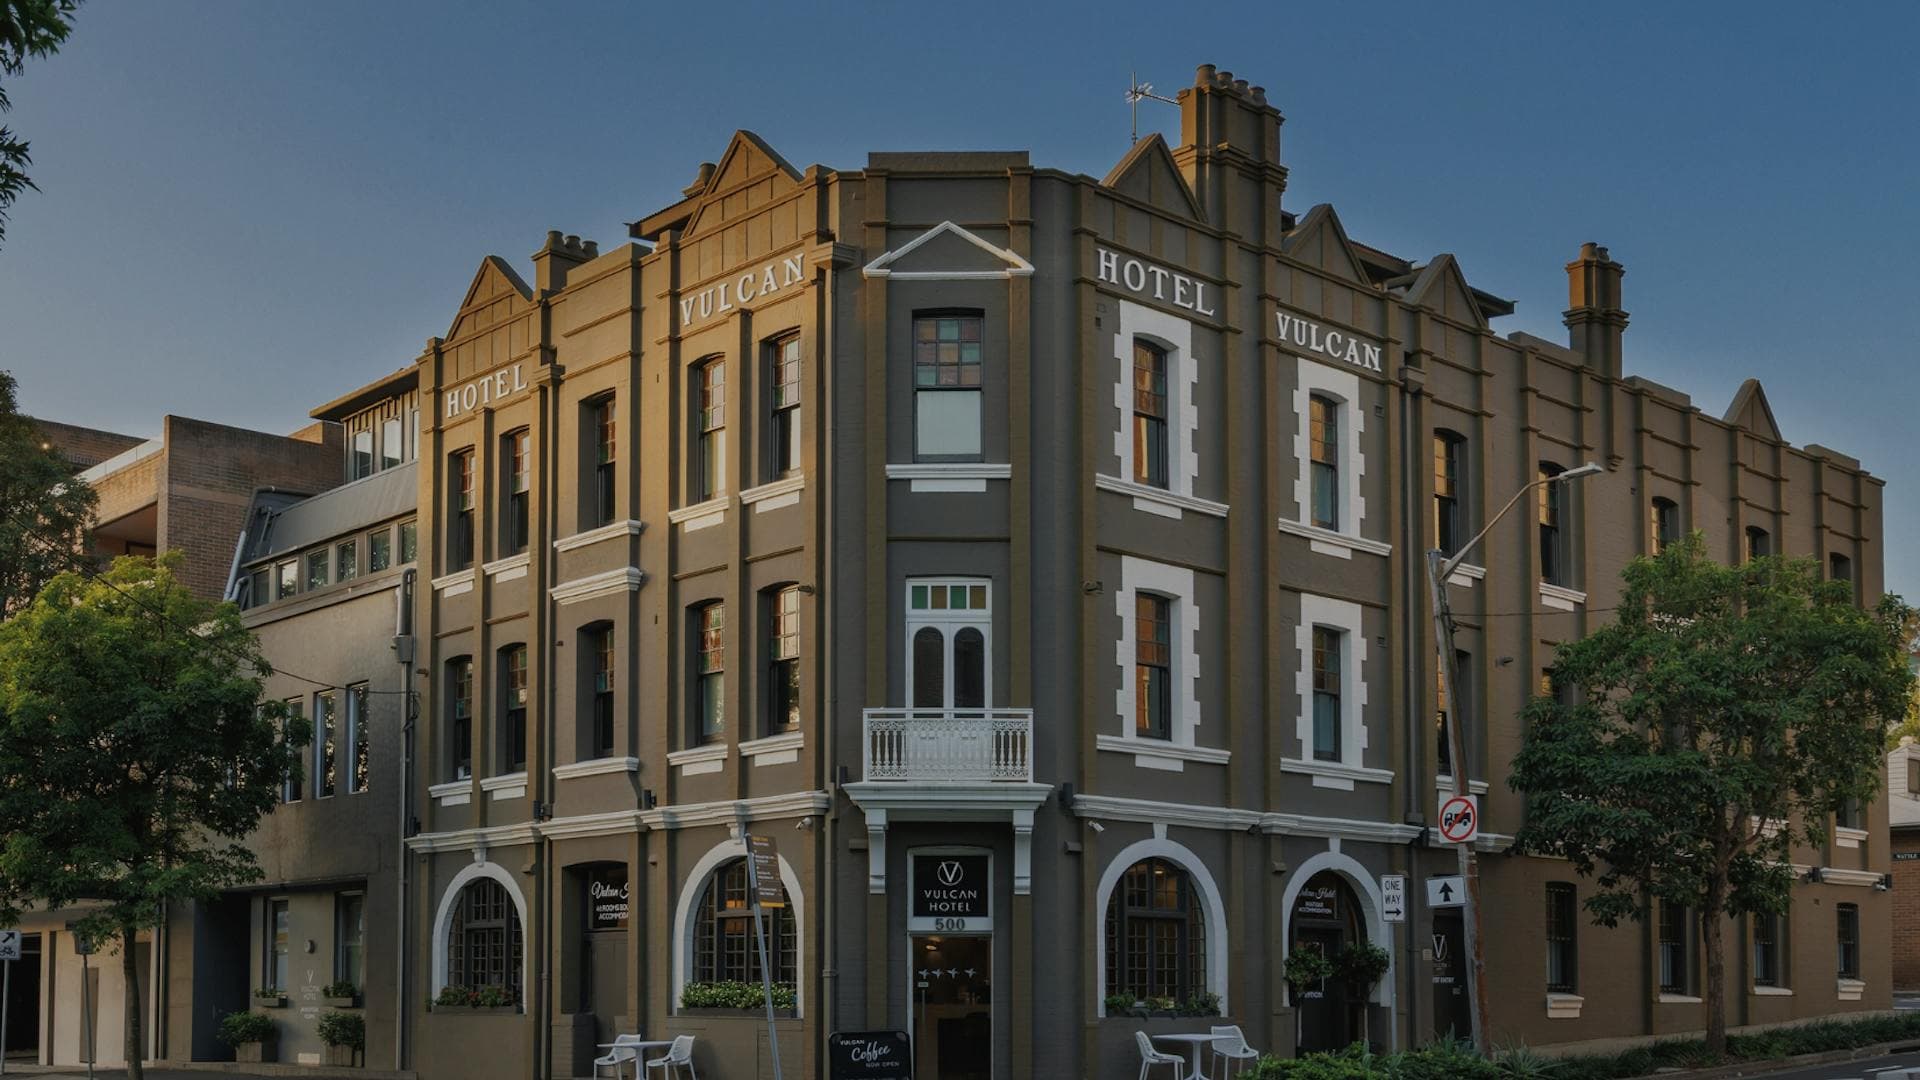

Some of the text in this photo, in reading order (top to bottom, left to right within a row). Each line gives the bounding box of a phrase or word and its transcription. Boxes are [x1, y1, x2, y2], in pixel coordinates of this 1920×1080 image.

[680, 253, 805, 326] VULCAN
[1097, 248, 1214, 316] HOTEL
[1276, 311, 1382, 372] VULCAN
[447, 364, 529, 419] HOTEL
[1384, 880, 1401, 891] ONE
[924, 890, 977, 899] VULCAN
[1384, 894, 1401, 905] WAY
[929, 902, 971, 912] HOTEL
[935, 918, 965, 931] 500
[851, 1041, 891, 1062] Coffee
